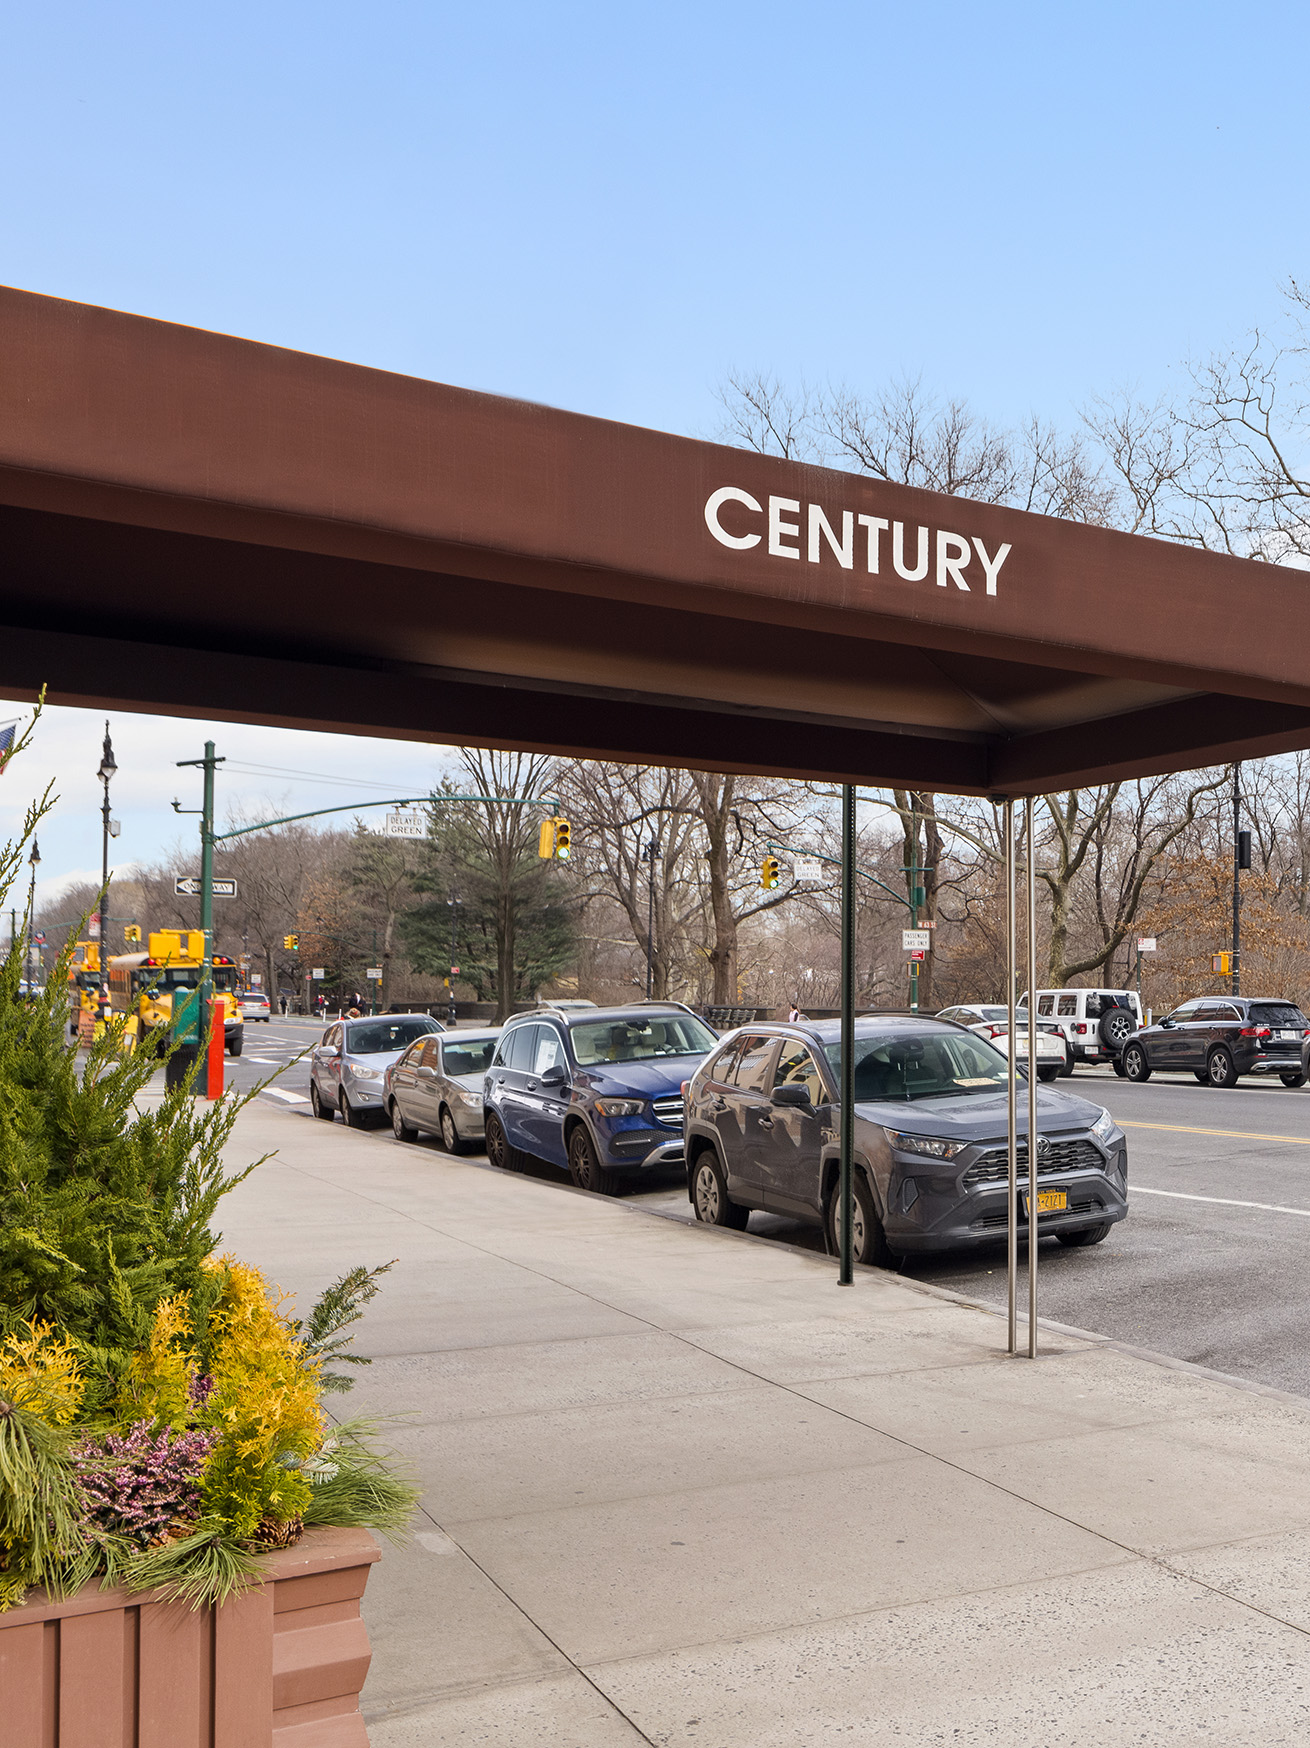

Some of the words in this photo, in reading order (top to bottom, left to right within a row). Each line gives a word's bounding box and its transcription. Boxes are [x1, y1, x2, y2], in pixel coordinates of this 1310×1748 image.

[704, 486, 1013, 597] CENTURY
[390, 816, 423, 826] DELAYED
[390, 825, 423, 836] GREEN
